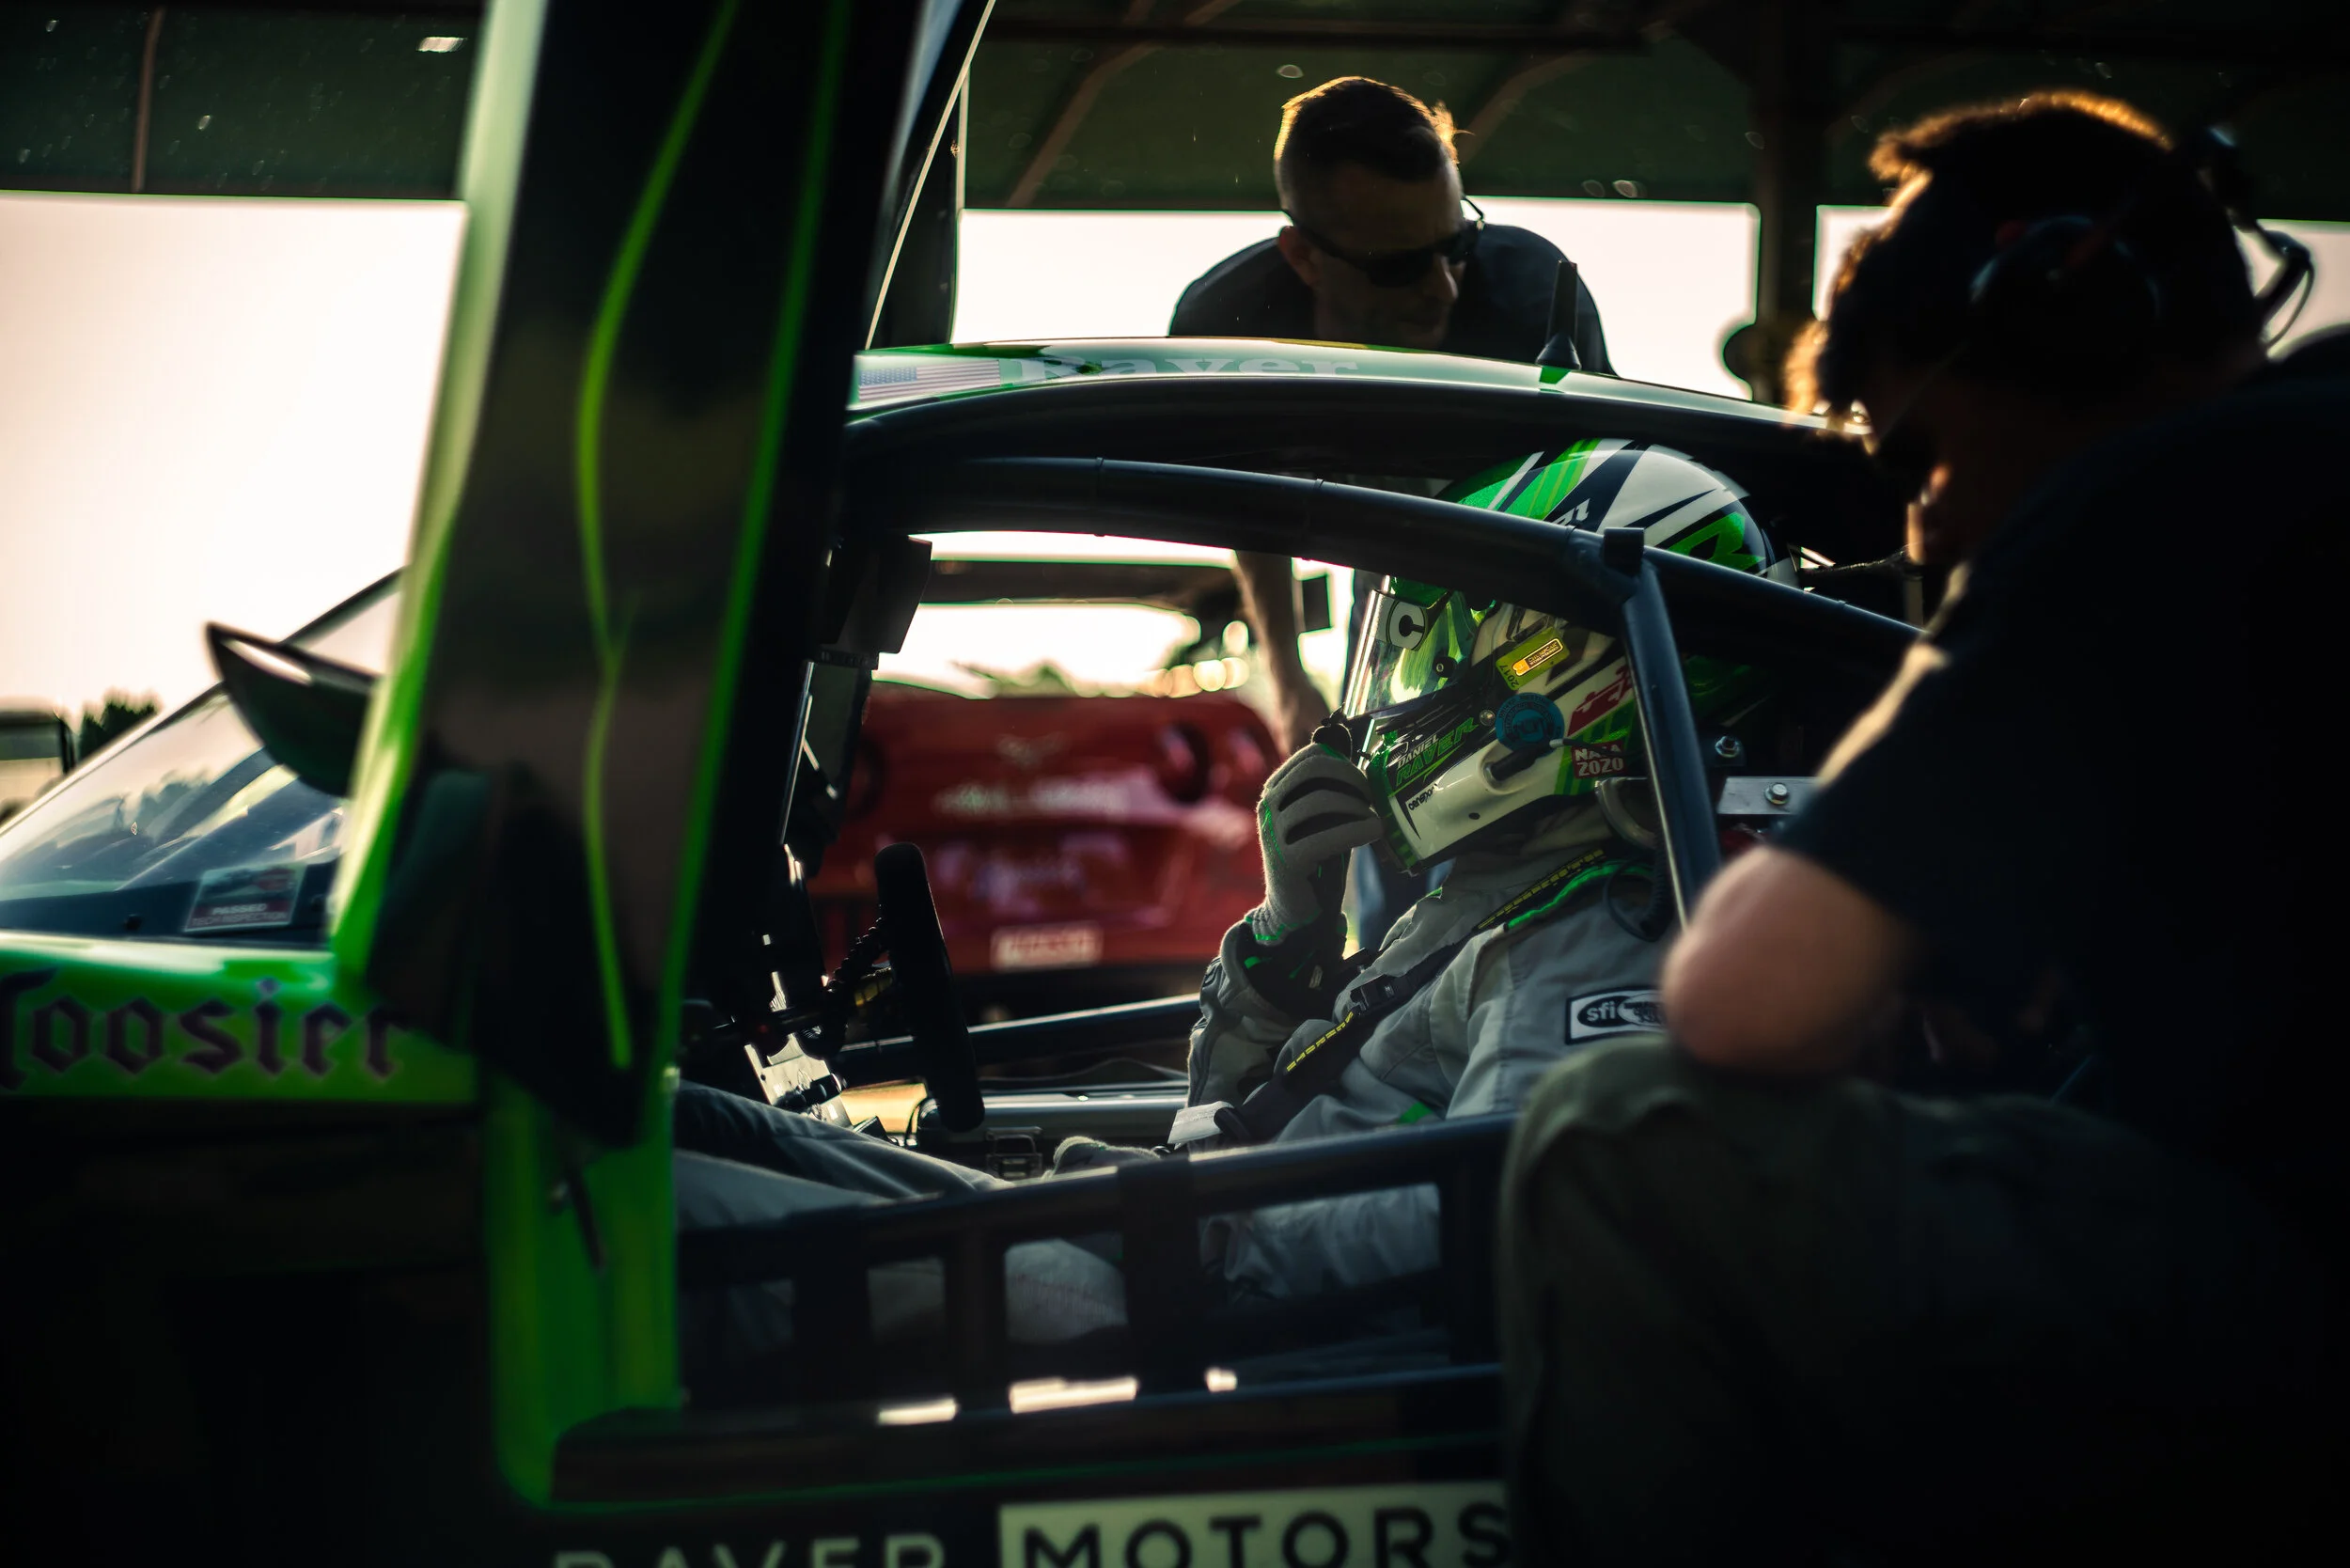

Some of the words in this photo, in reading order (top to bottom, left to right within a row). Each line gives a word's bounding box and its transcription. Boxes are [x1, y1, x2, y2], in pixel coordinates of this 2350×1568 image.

[1010, 355, 1358, 384] Raver
[1499, 664, 1519, 688] 2017
[1396, 717, 1480, 787] RAVER
[1398, 734, 1439, 770] DANIEL
[1574, 744, 1622, 761] NAA
[1576, 757, 1624, 777] 2020
[212, 902, 267, 916] PASSED
[1587, 1000, 1617, 1023] sfi
[1022, 1503, 1512, 1568] MOTORS
